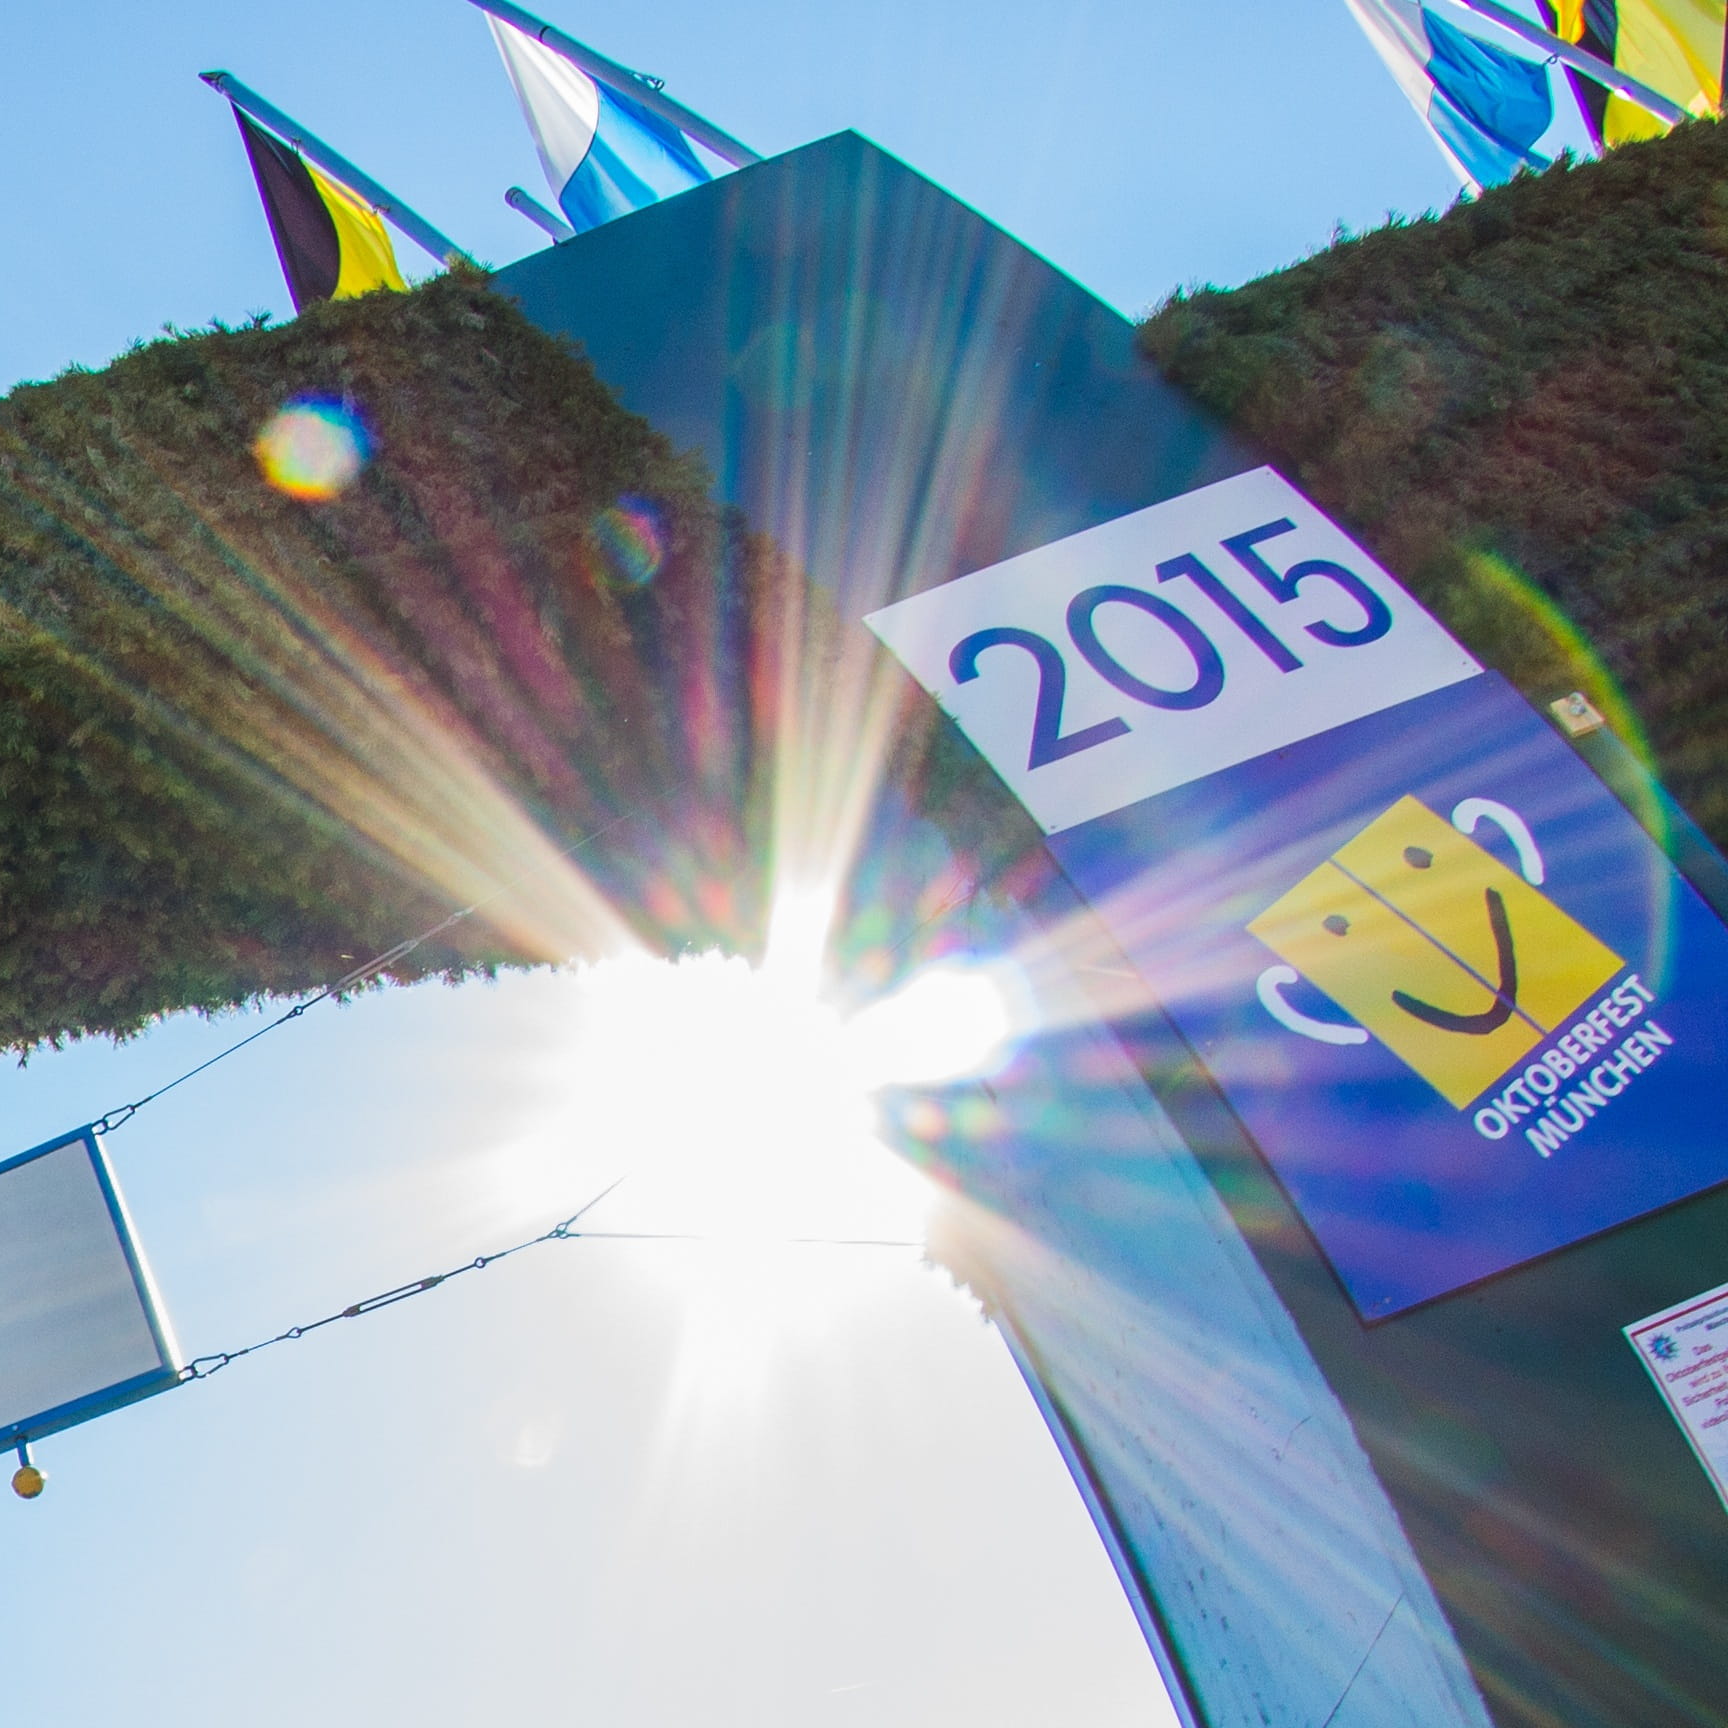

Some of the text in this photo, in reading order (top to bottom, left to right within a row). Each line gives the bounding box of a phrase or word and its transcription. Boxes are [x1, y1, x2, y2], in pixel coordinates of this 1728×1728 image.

[947, 517, 1394, 772] 2015
[1474, 974, 1655, 1140] OKTOBERFEST
[1525, 1020, 1673, 1157] MÜNCHEN
